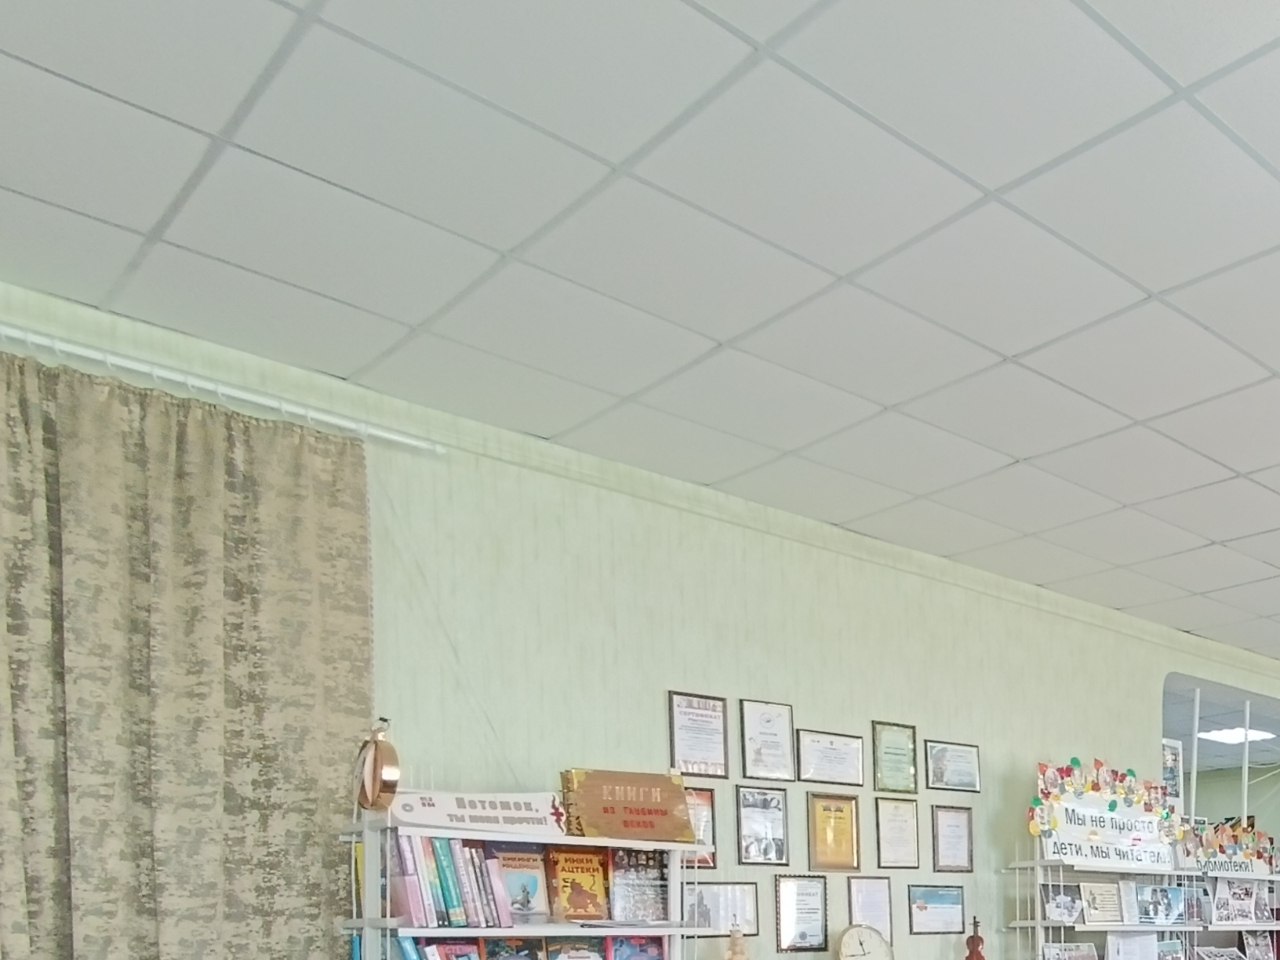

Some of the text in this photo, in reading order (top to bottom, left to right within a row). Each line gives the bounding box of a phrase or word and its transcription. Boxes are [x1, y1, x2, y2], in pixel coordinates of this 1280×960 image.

[602, 784, 661, 803] КНИГИ
[1064, 807, 1154, 834] Мы не просто
[563, 856, 594, 865] ИНКИ
[560, 865, 600, 874] АЦТЕКИ
